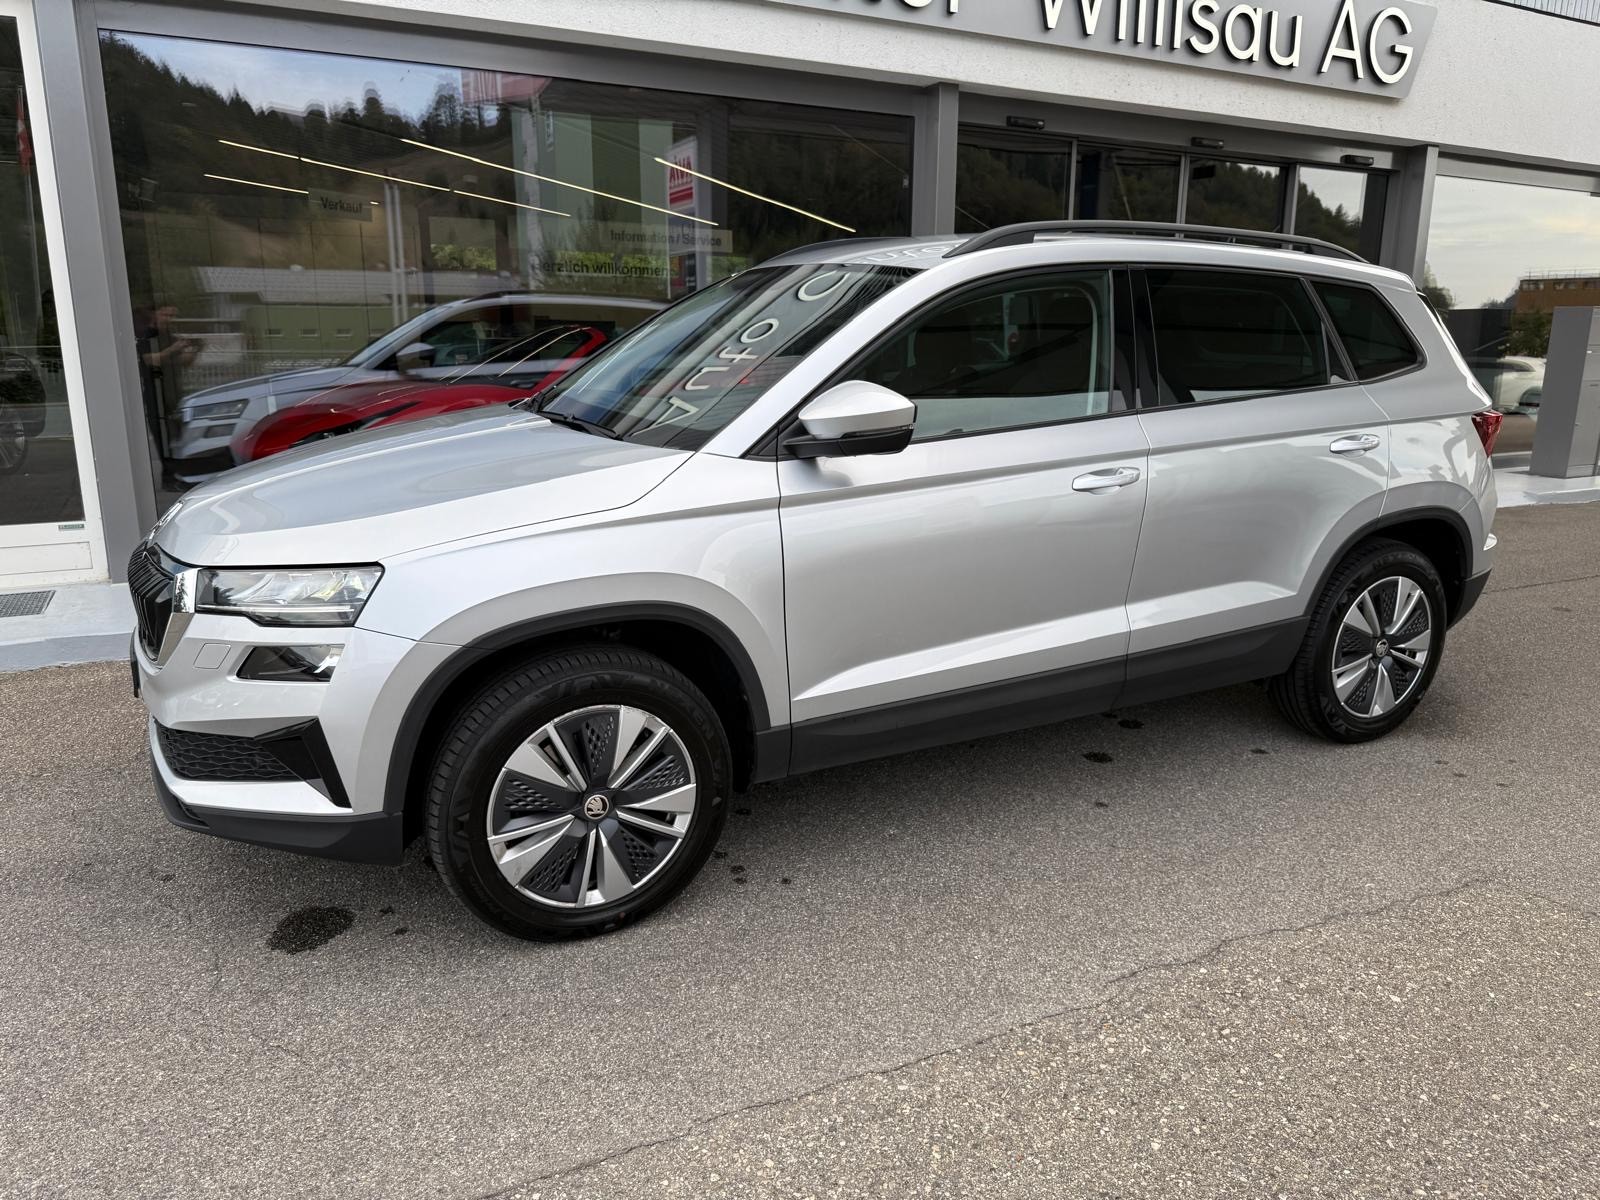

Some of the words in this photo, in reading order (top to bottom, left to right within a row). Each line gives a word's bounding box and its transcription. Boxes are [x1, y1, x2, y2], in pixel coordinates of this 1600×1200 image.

[1319, 0, 1414, 84] AG
[320, 196, 363, 214] Verkauf
[682, 233, 722, 247] Service
[533, 260, 589, 273] erzlich
[592, 262, 668, 277] willkommen
